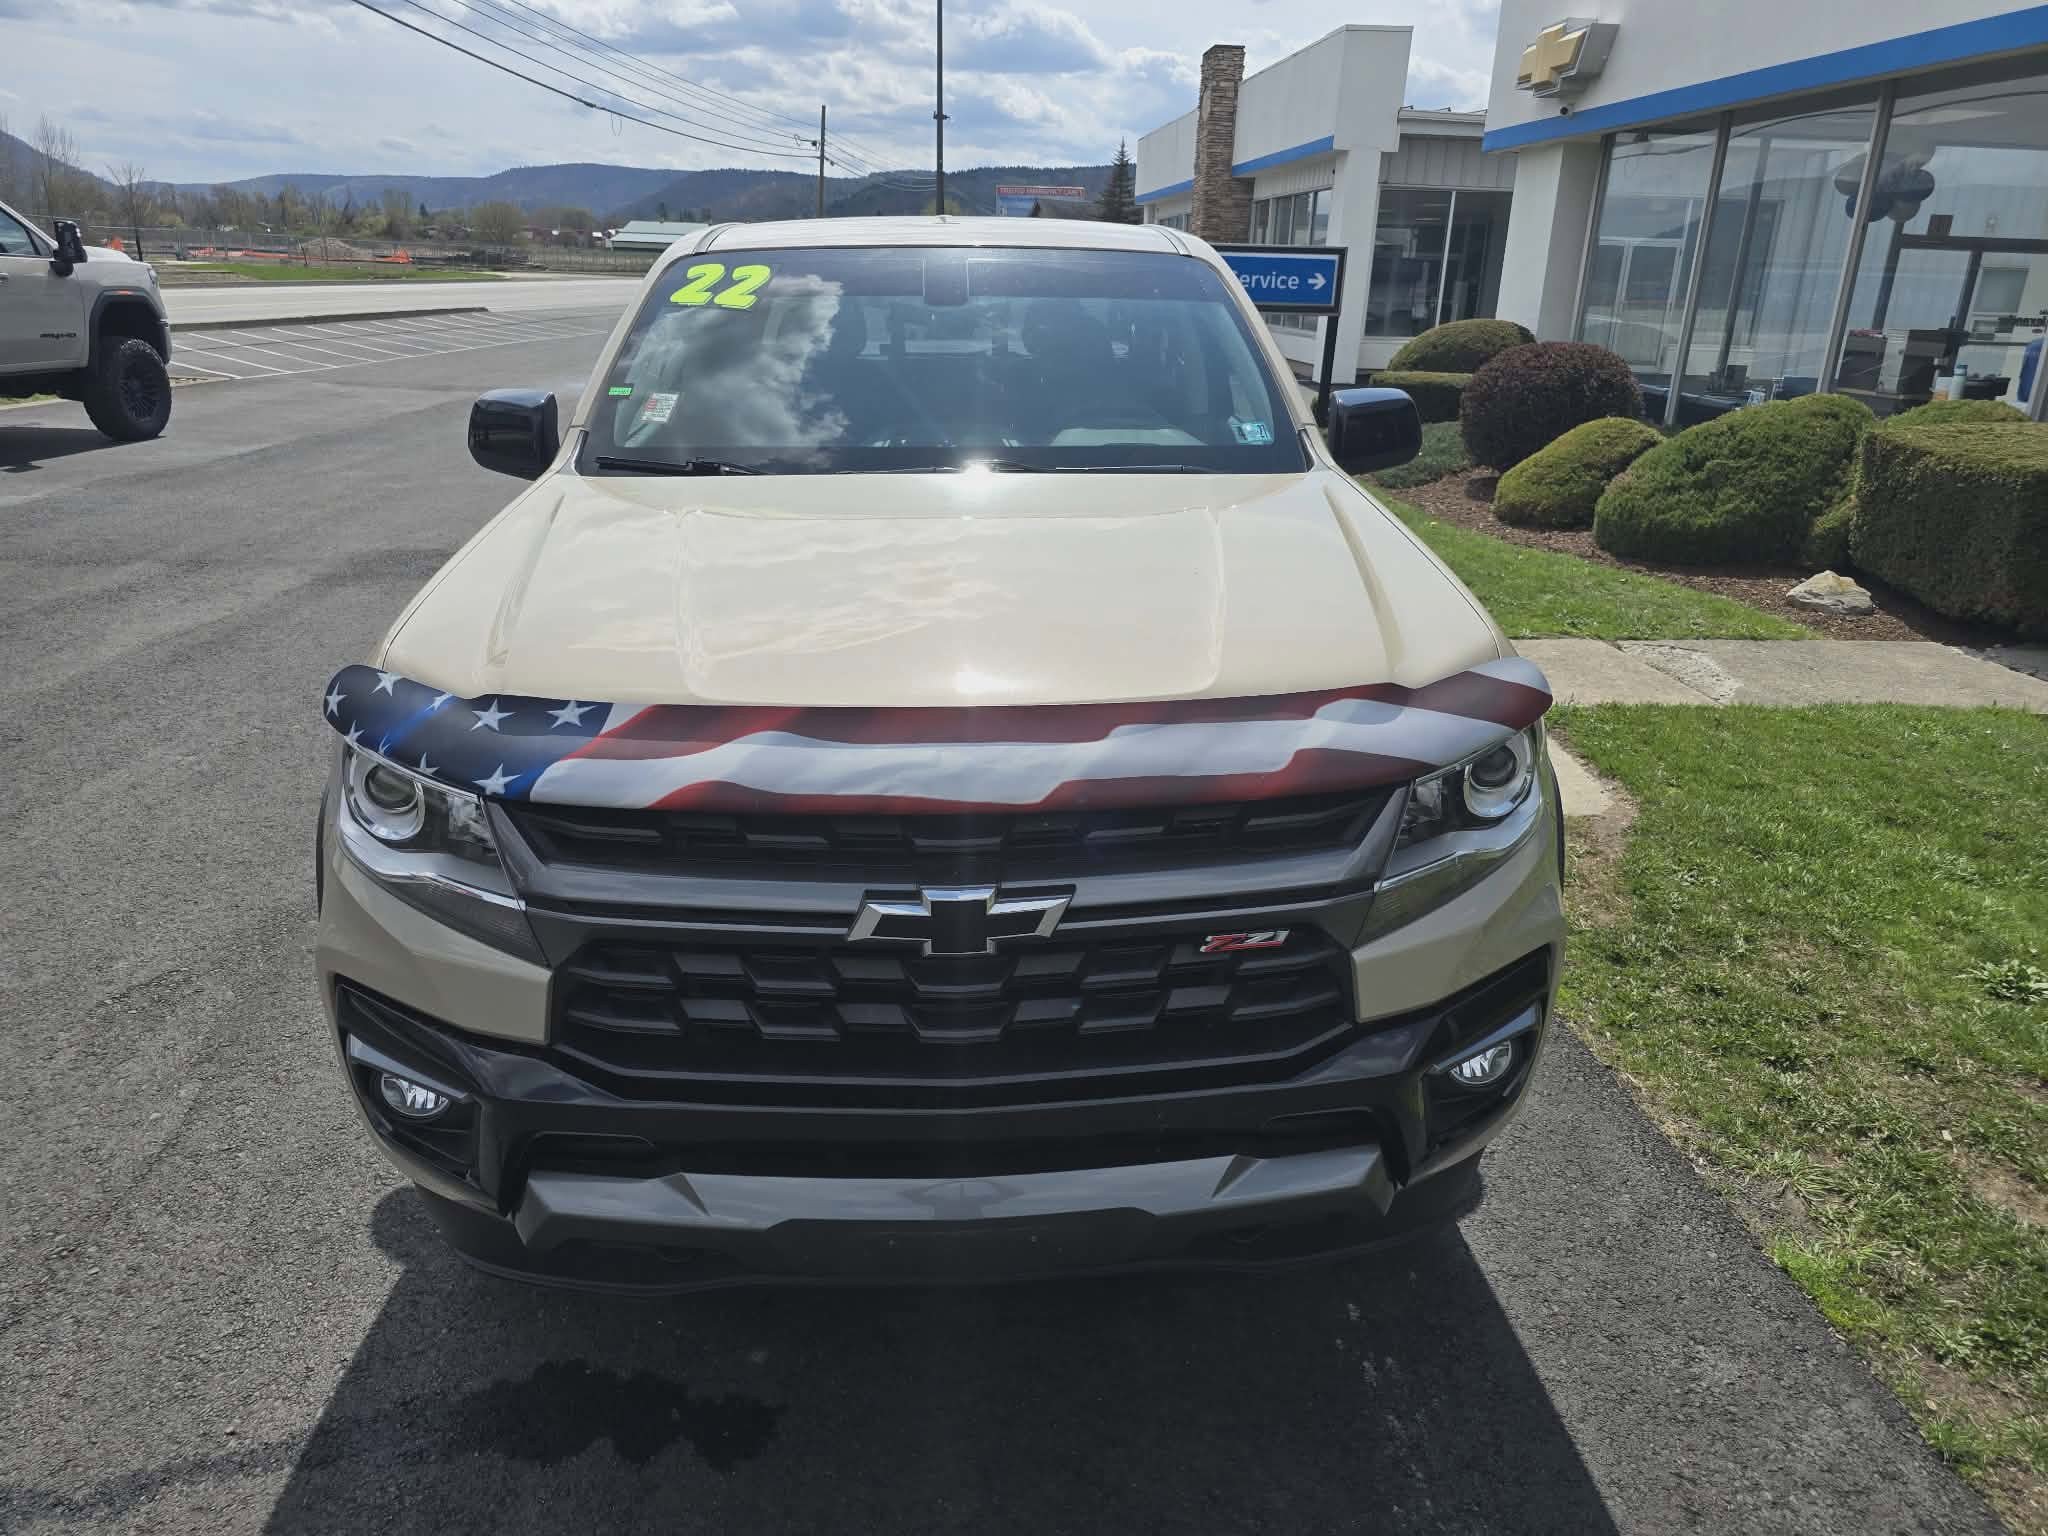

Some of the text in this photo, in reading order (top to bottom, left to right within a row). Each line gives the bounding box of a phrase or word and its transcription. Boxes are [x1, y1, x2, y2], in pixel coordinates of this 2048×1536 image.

[669, 263, 771, 309] 22
[1232, 270, 1300, 290] ervice
[1199, 930, 1290, 953] Z71
